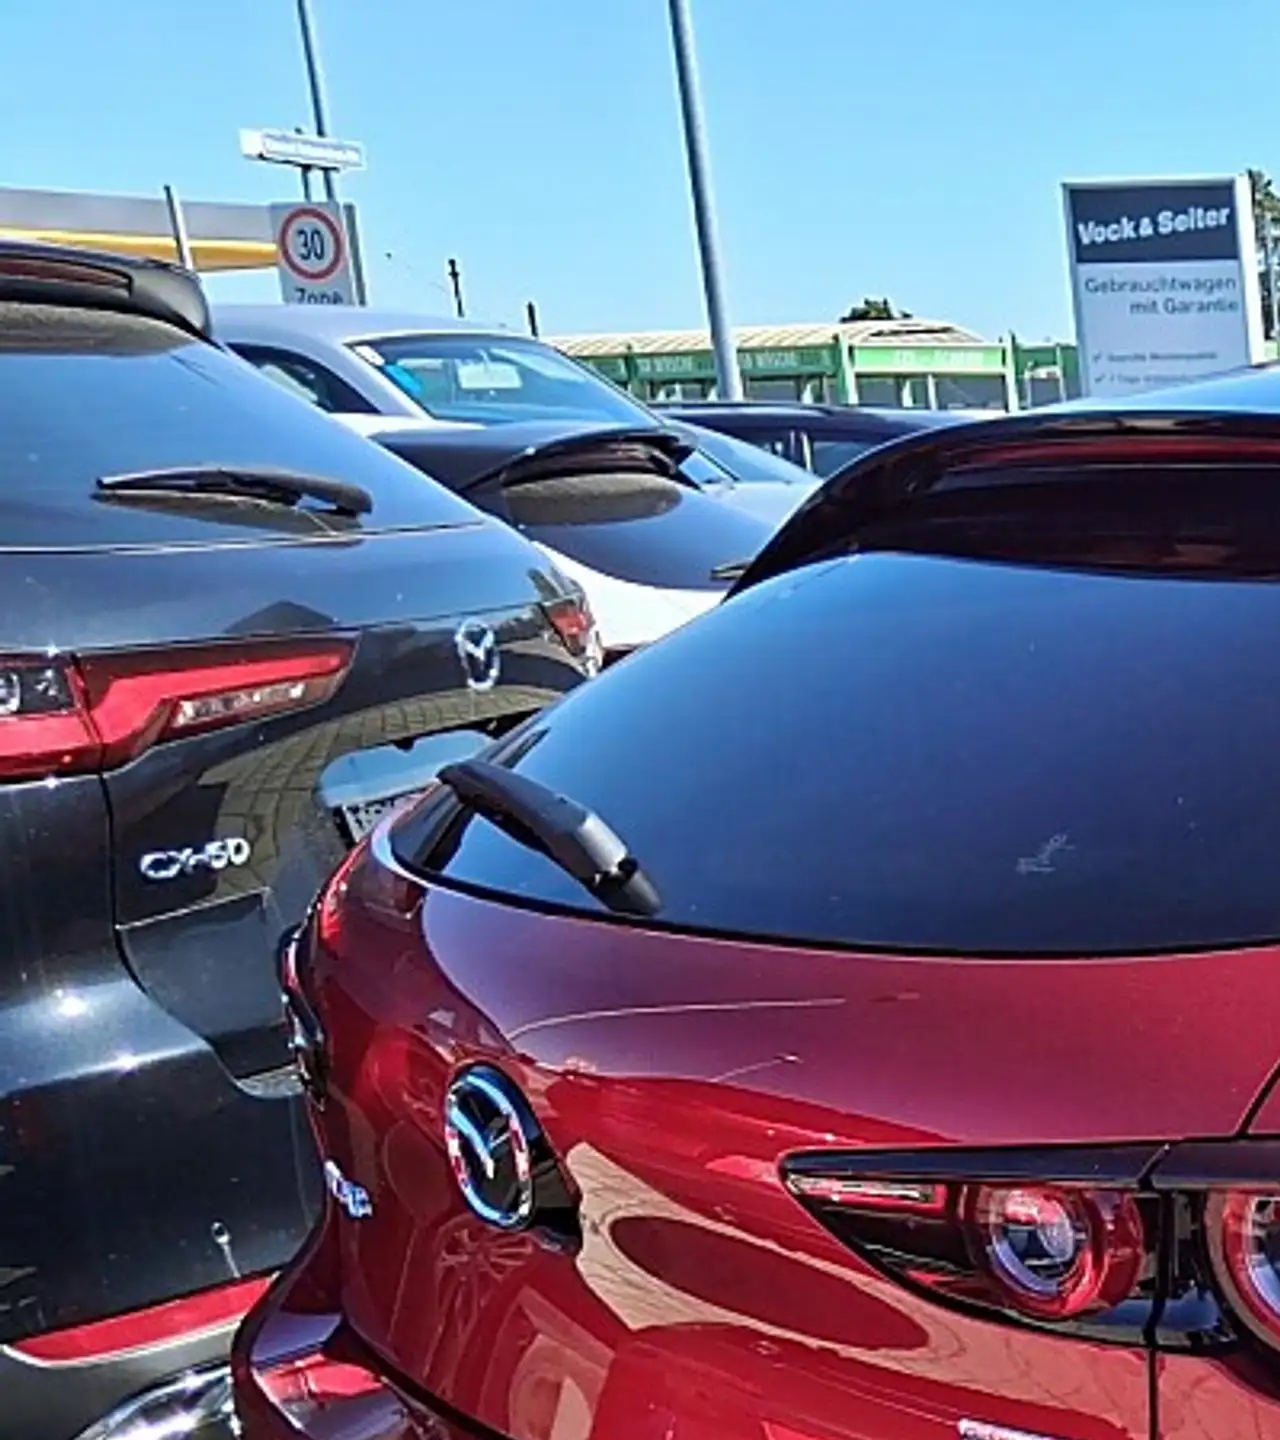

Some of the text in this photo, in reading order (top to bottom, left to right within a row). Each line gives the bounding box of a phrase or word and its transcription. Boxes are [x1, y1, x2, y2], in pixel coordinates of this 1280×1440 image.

[1077, 216, 1137, 245] Vock
[1139, 217, 1153, 237] &
[296, 228, 325, 261] 30
[1085, 276, 1237, 295] Gebrauchtwagen
[1130, 299, 1239, 315] mit Garantie
